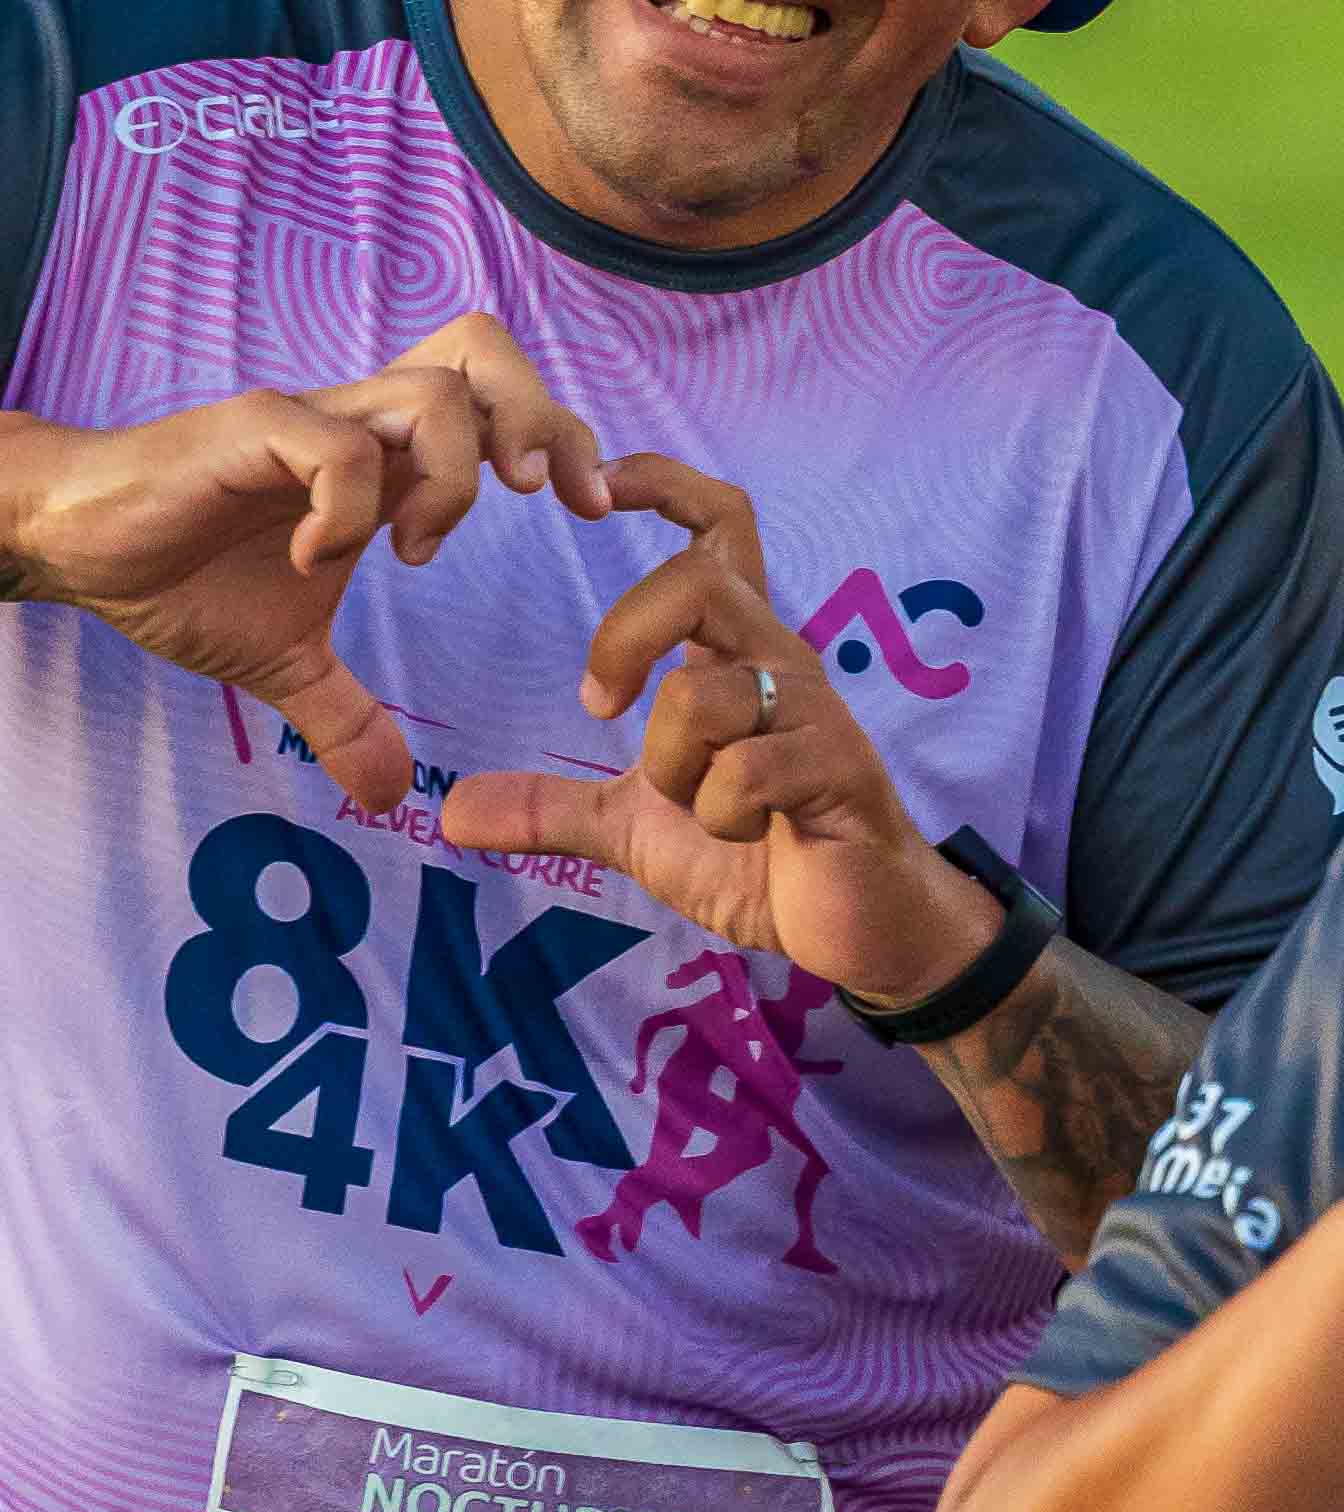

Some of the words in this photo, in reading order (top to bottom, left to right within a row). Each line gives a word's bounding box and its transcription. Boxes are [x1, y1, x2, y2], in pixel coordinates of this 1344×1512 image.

[164, 812, 654, 1170] 8K
[222, 1031, 567, 1257] 4K
[367, 1426, 567, 1497] Maratón
